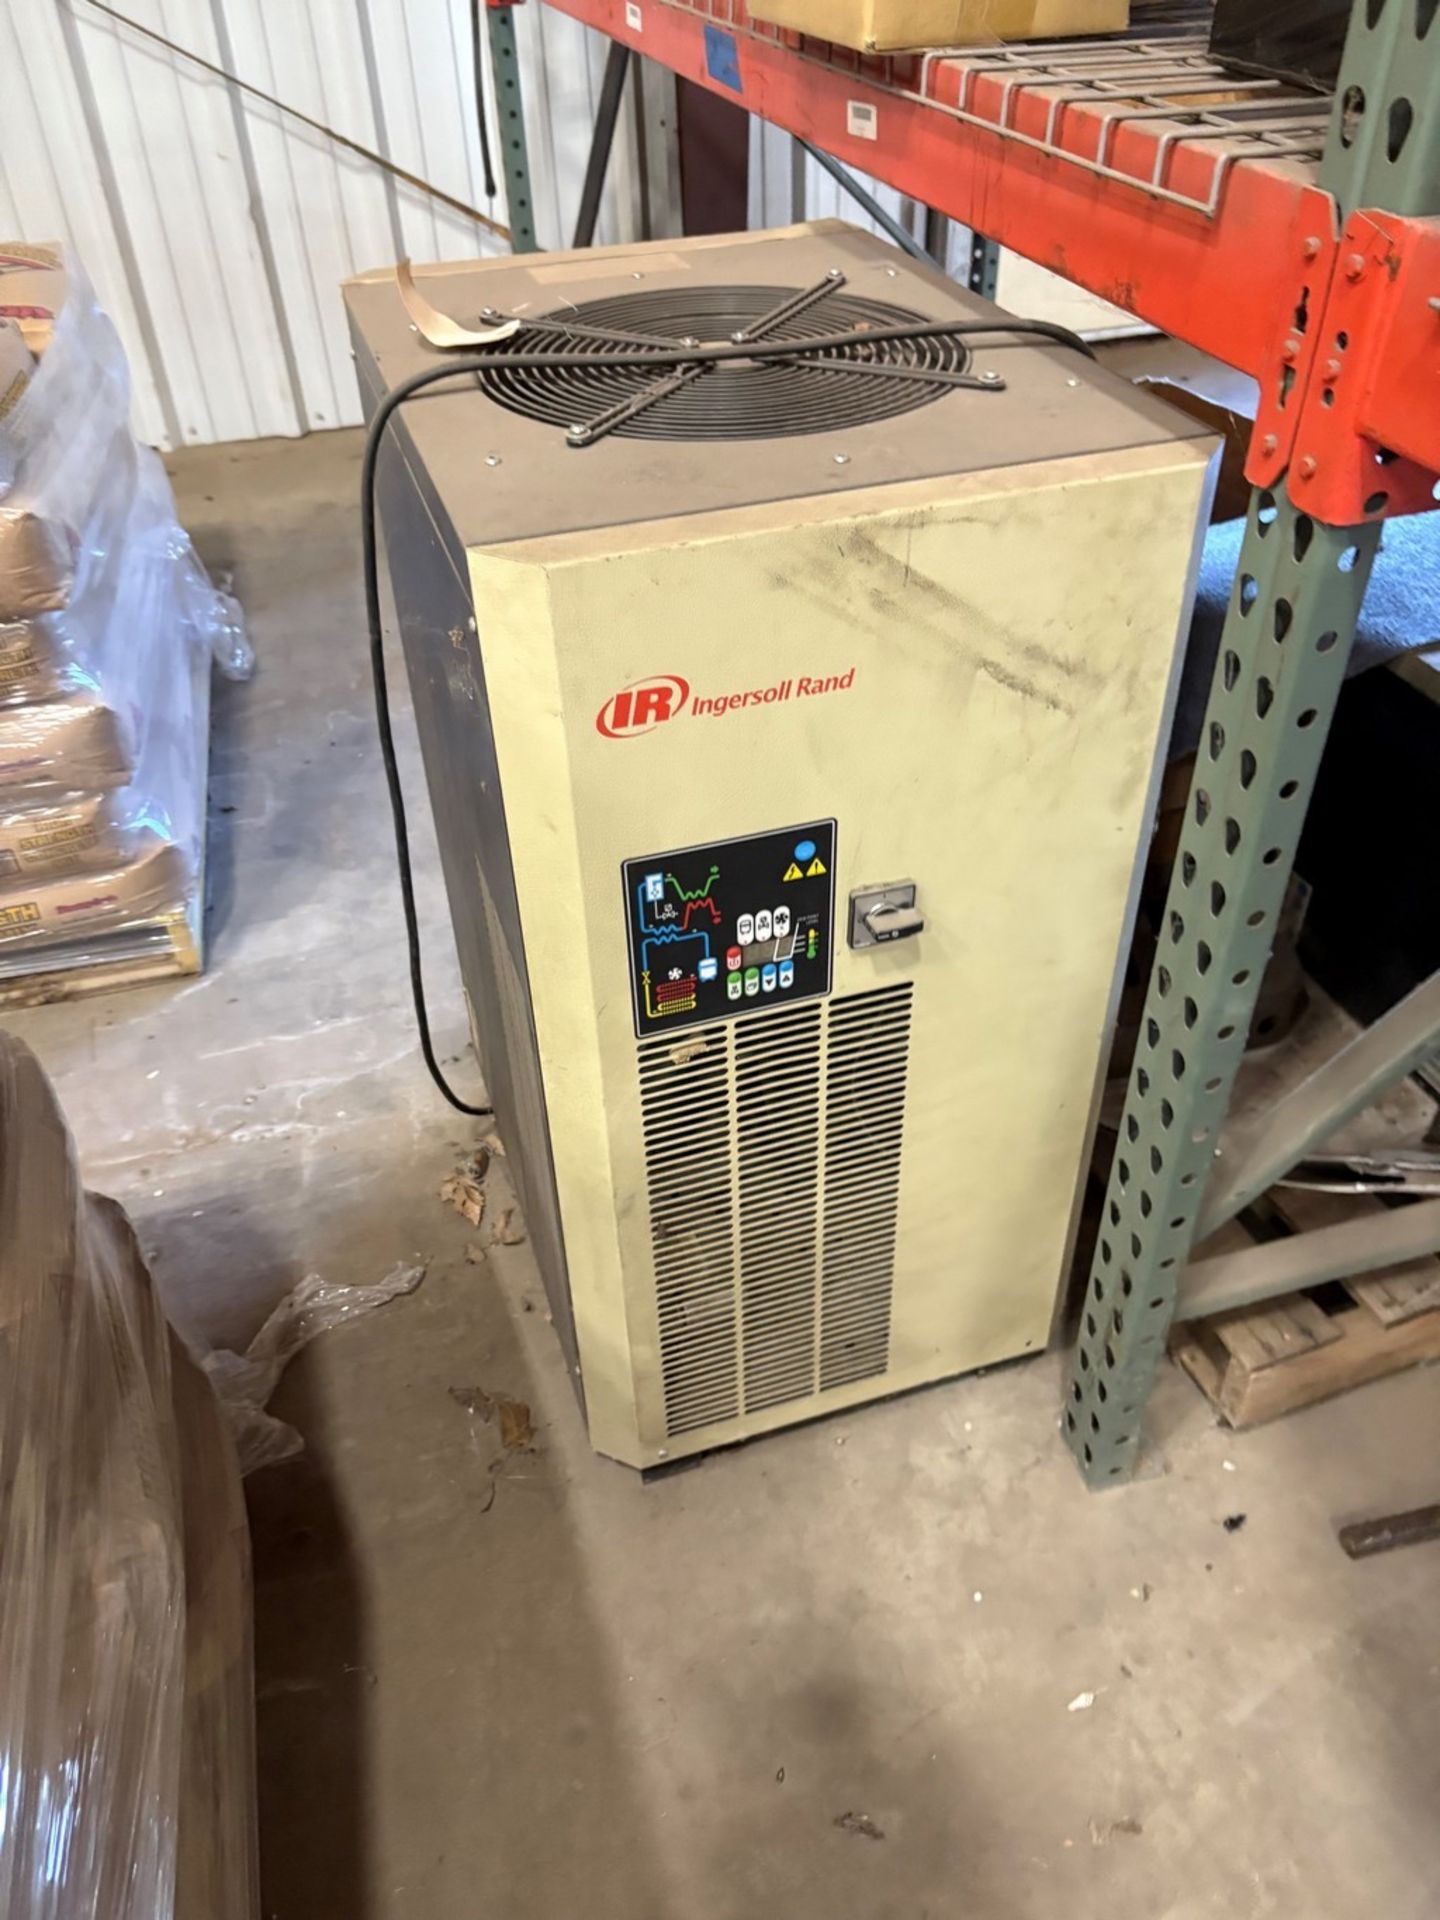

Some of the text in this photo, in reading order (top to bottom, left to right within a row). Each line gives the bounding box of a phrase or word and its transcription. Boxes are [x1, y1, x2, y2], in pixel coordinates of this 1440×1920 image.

[611, 667, 855, 730] IR Ingersoll Rand
